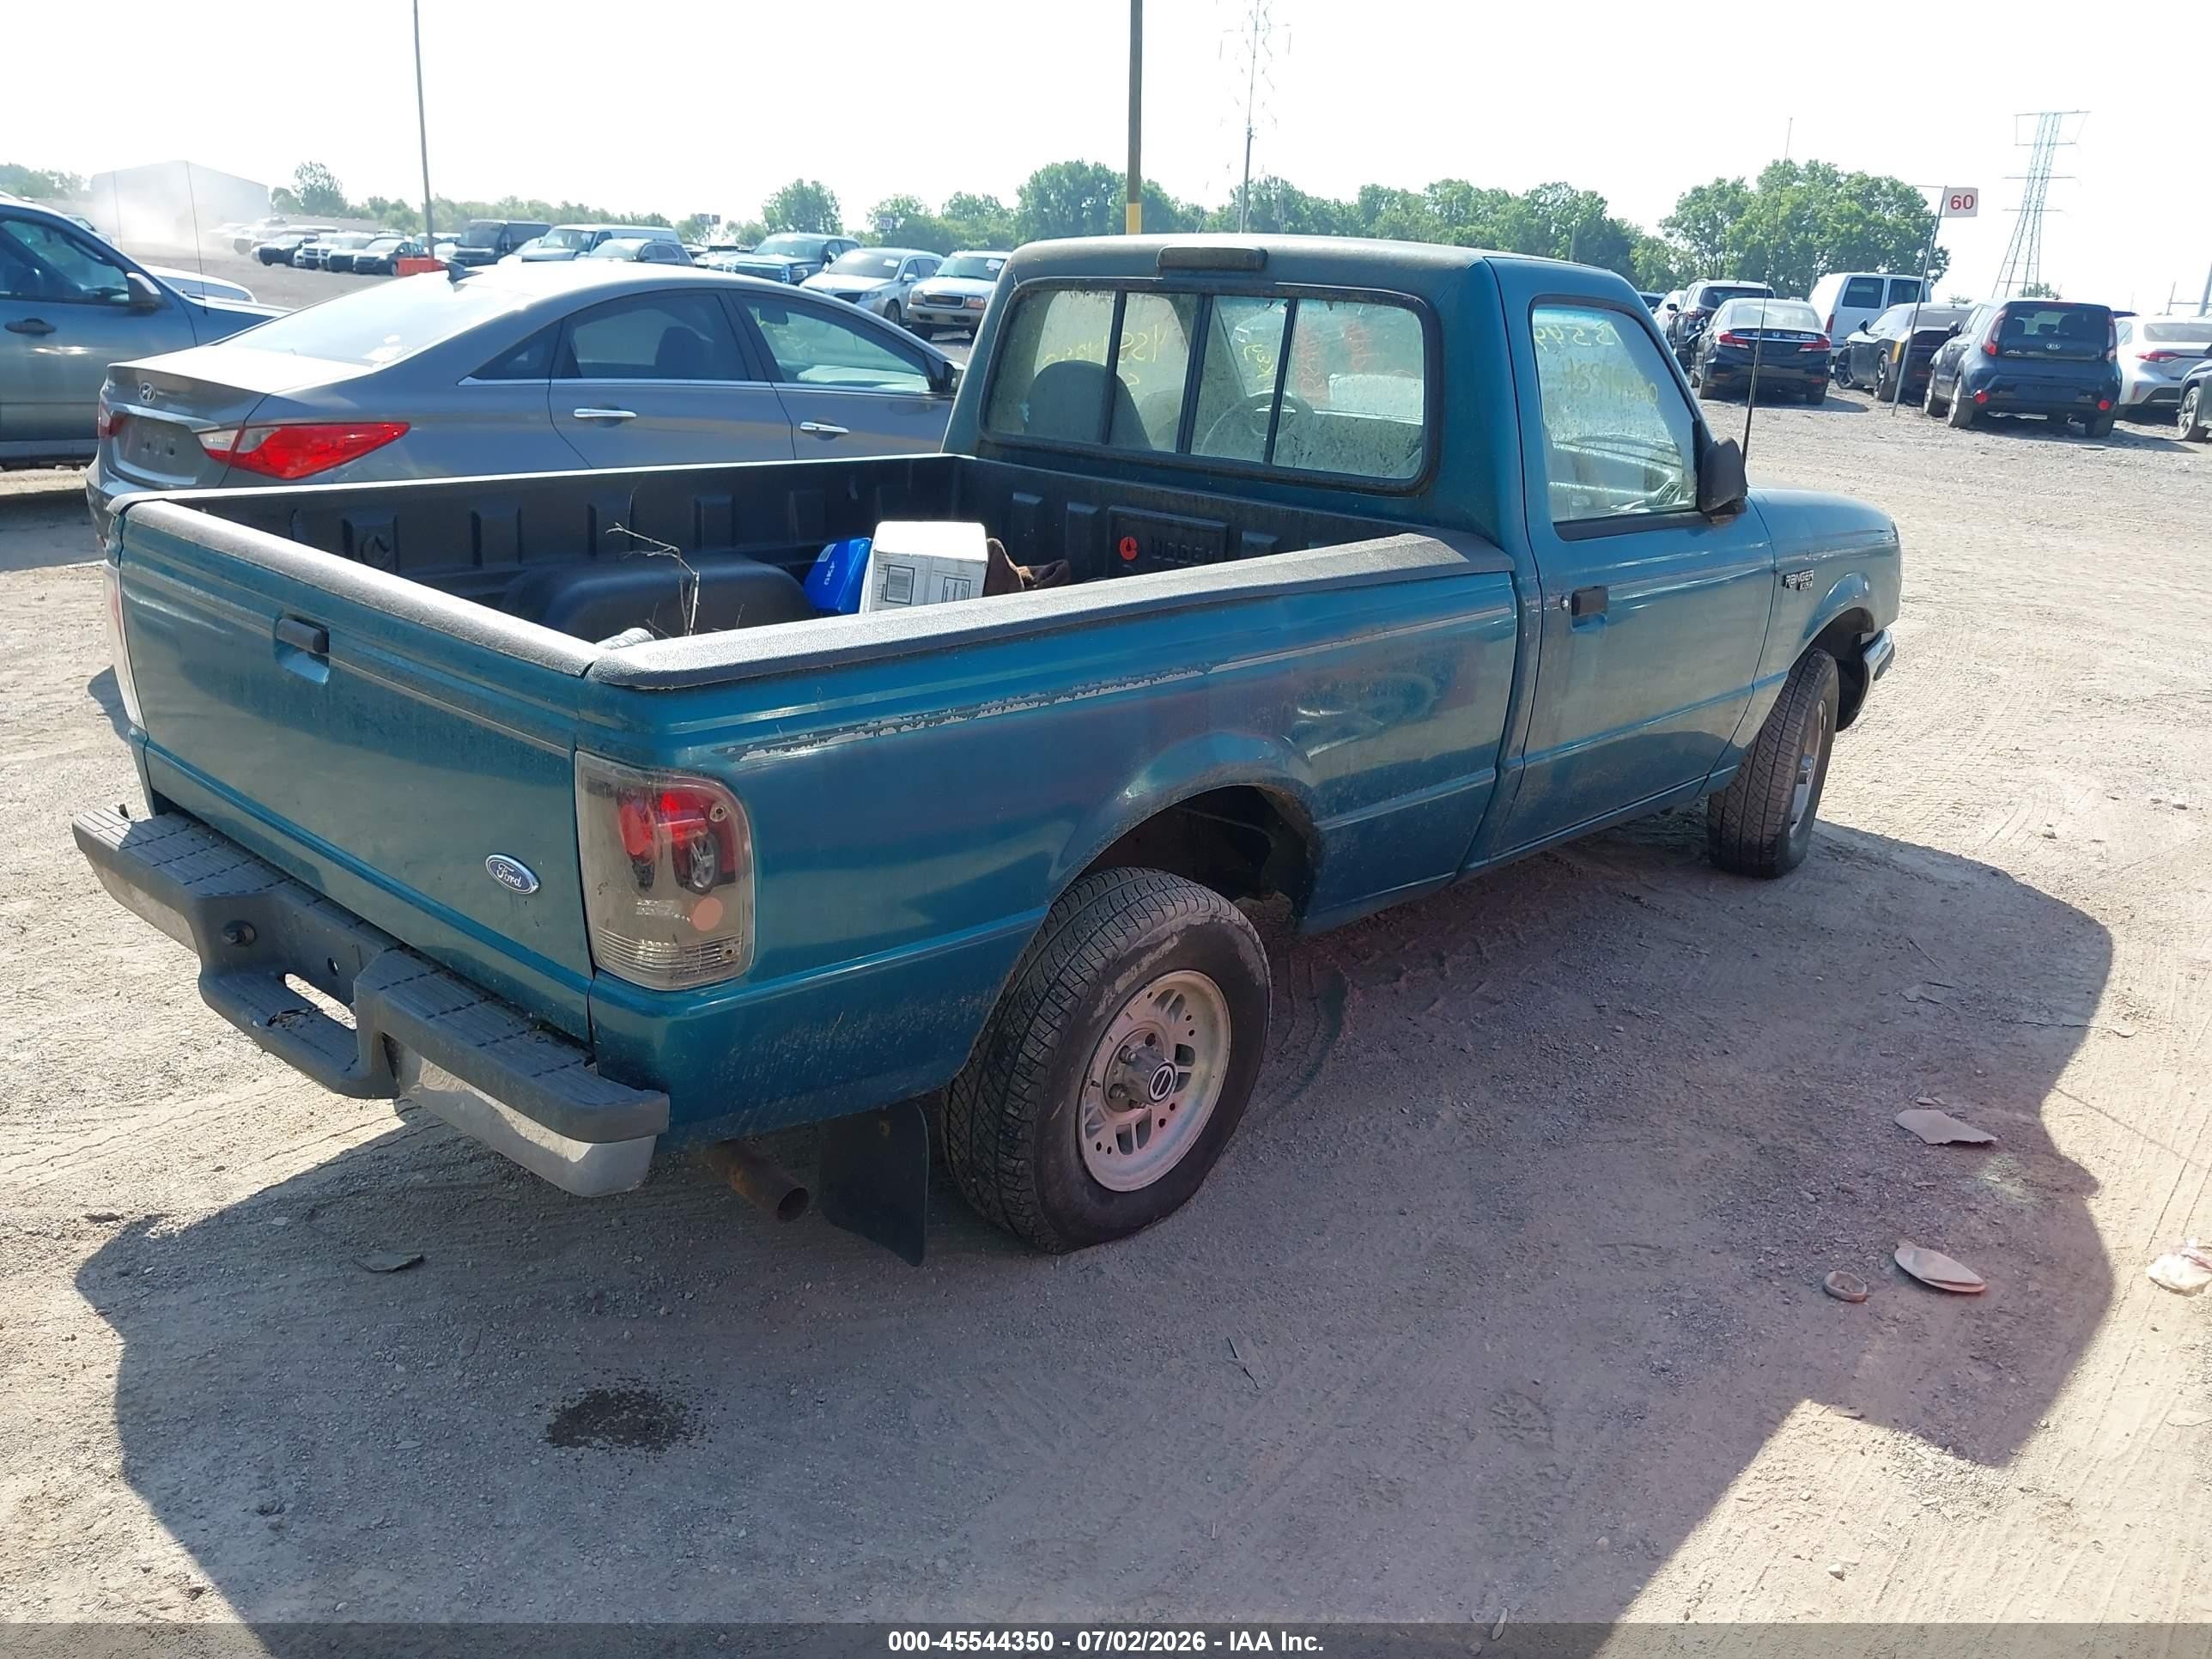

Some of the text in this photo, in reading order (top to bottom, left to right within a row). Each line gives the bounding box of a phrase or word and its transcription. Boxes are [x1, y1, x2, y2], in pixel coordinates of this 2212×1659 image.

[1950, 194, 1974, 210] 60
[1786, 570, 1814, 588] RANGER
[496, 863, 522, 888] Ford
